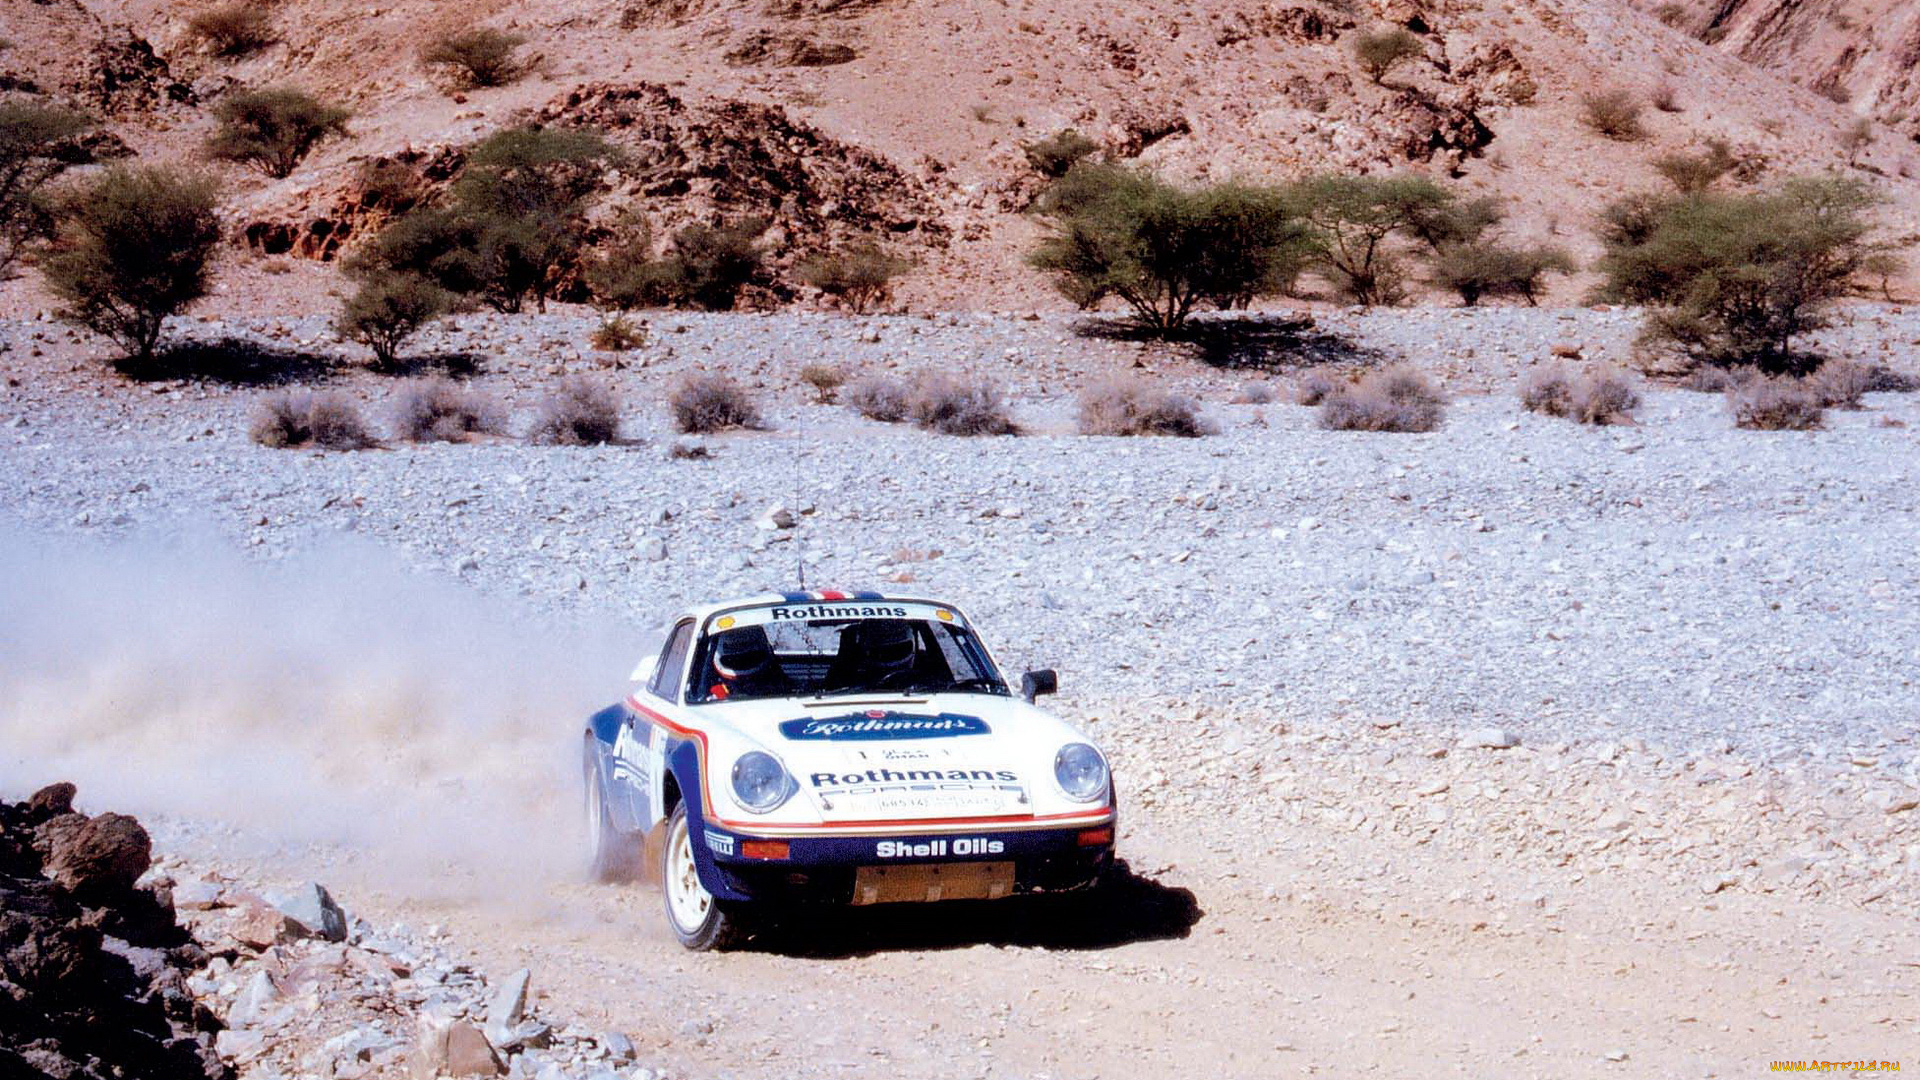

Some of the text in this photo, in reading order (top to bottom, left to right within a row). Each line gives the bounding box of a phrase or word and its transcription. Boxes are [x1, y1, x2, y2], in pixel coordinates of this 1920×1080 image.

[771, 605, 908, 620] Rothmans
[803, 719, 975, 735] Rothmans
[810, 769, 1018, 787] Rothmans
[876, 838, 1005, 858] Shell Oils
